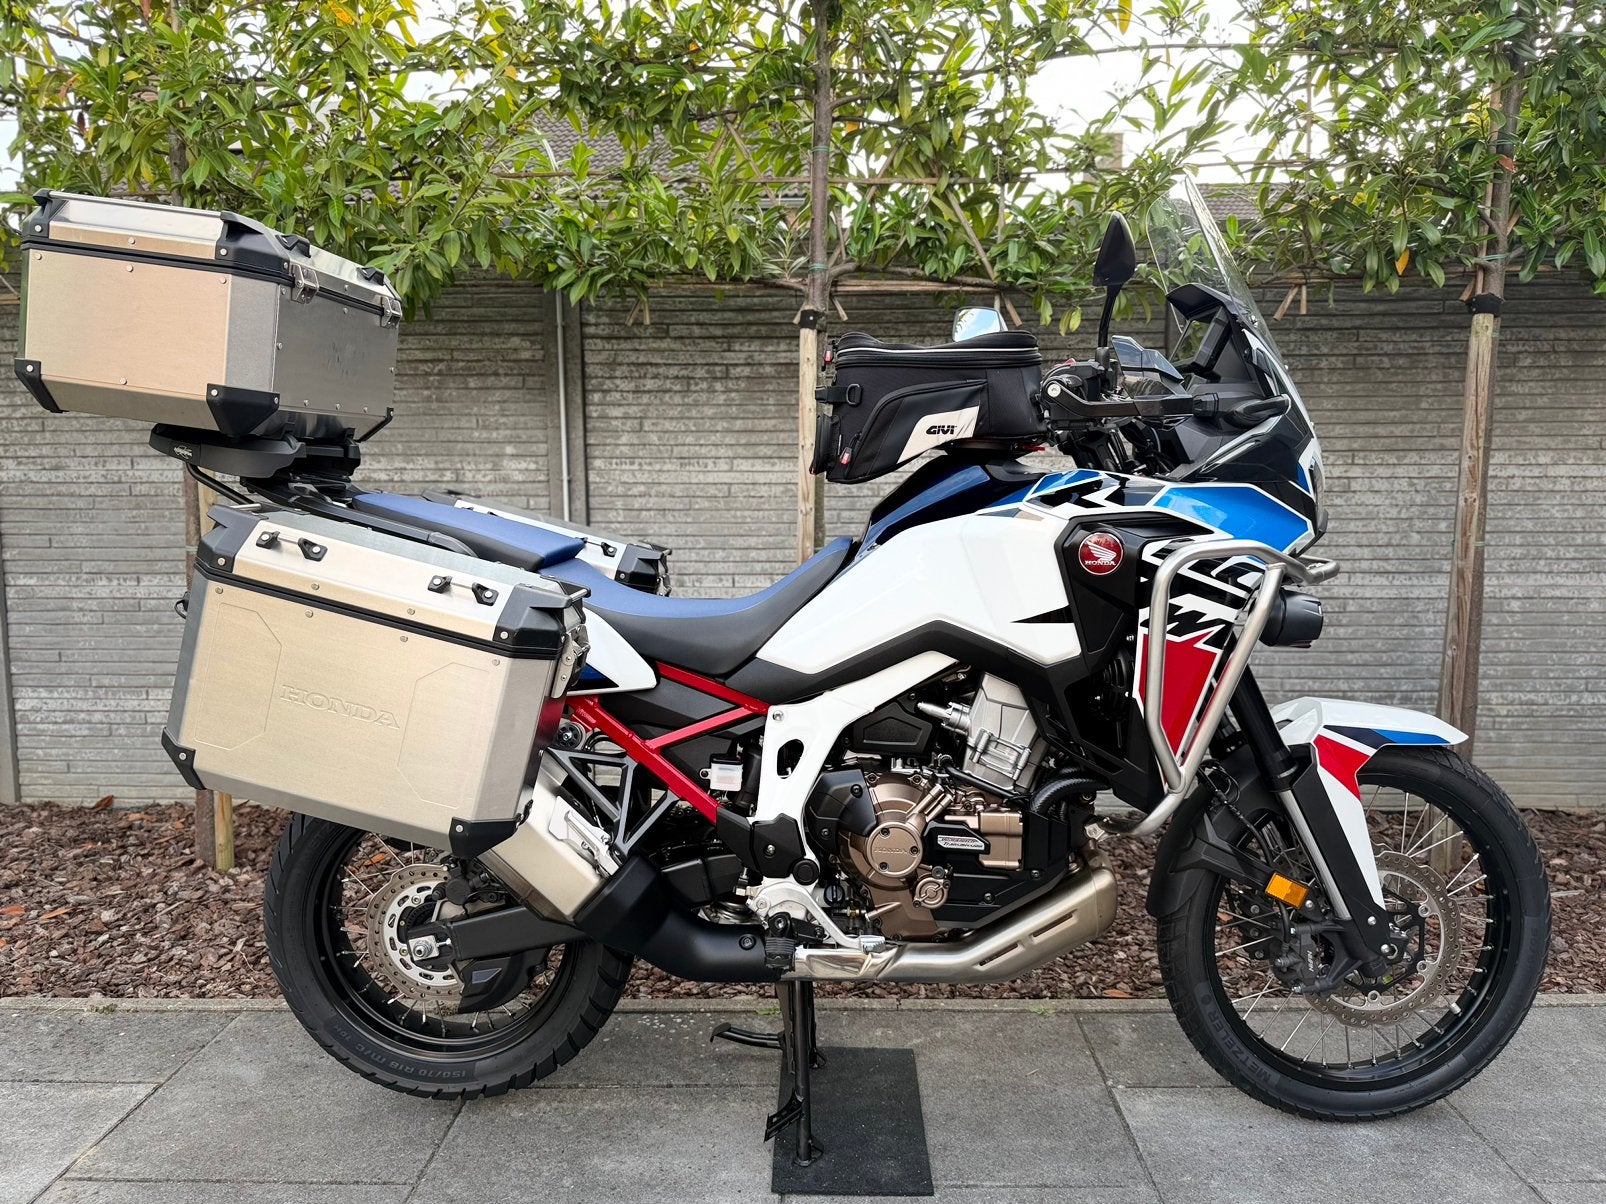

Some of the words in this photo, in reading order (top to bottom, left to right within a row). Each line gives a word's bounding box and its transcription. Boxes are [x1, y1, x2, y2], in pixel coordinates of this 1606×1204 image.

[925, 424, 957, 435] GIVI
[1084, 559, 1117, 567] HONDA
[280, 684, 400, 730] HONDA
[1207, 1009, 1272, 1084] METZELER
[387, 1060, 417, 1075] R18
[418, 1068, 468, 1079] 150/70
